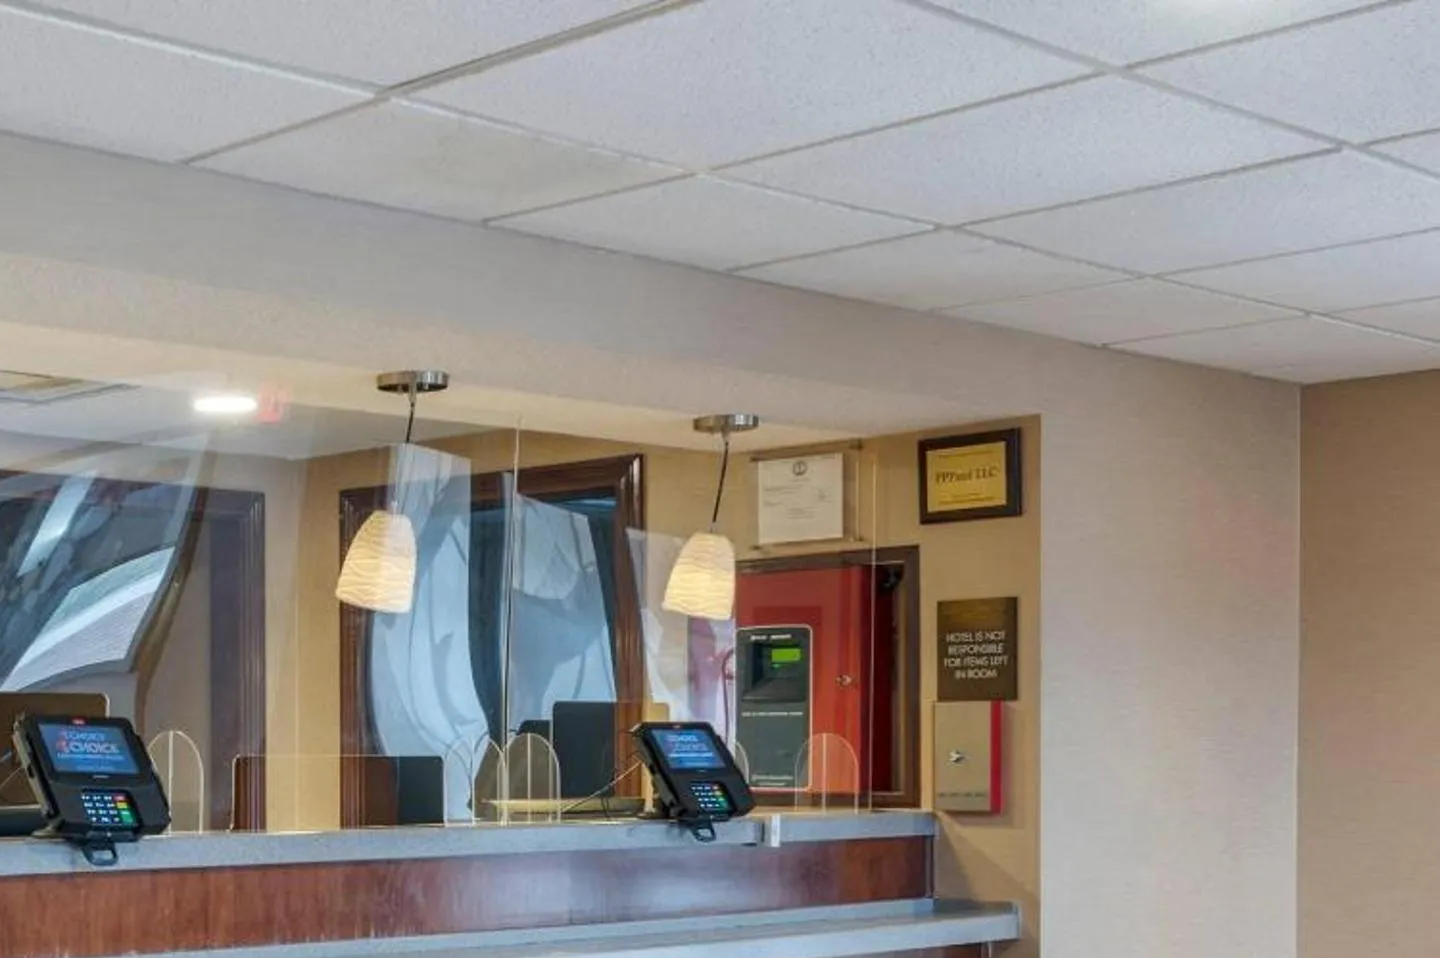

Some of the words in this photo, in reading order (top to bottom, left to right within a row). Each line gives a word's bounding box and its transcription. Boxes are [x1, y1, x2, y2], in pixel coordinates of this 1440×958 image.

[975, 466, 998, 479] LLC
[946, 631, 973, 642] HOTEL
[975, 631, 983, 642] IS
[985, 630, 1005, 640] NOT
[948, 643, 1004, 655] RESPONSIBLE
[944, 657, 961, 668] FOR
[963, 656, 989, 667] ITEMS
[990, 655, 1008, 665] LEFT
[955, 669, 966, 679] IN
[967, 668, 997, 678] ROOM
